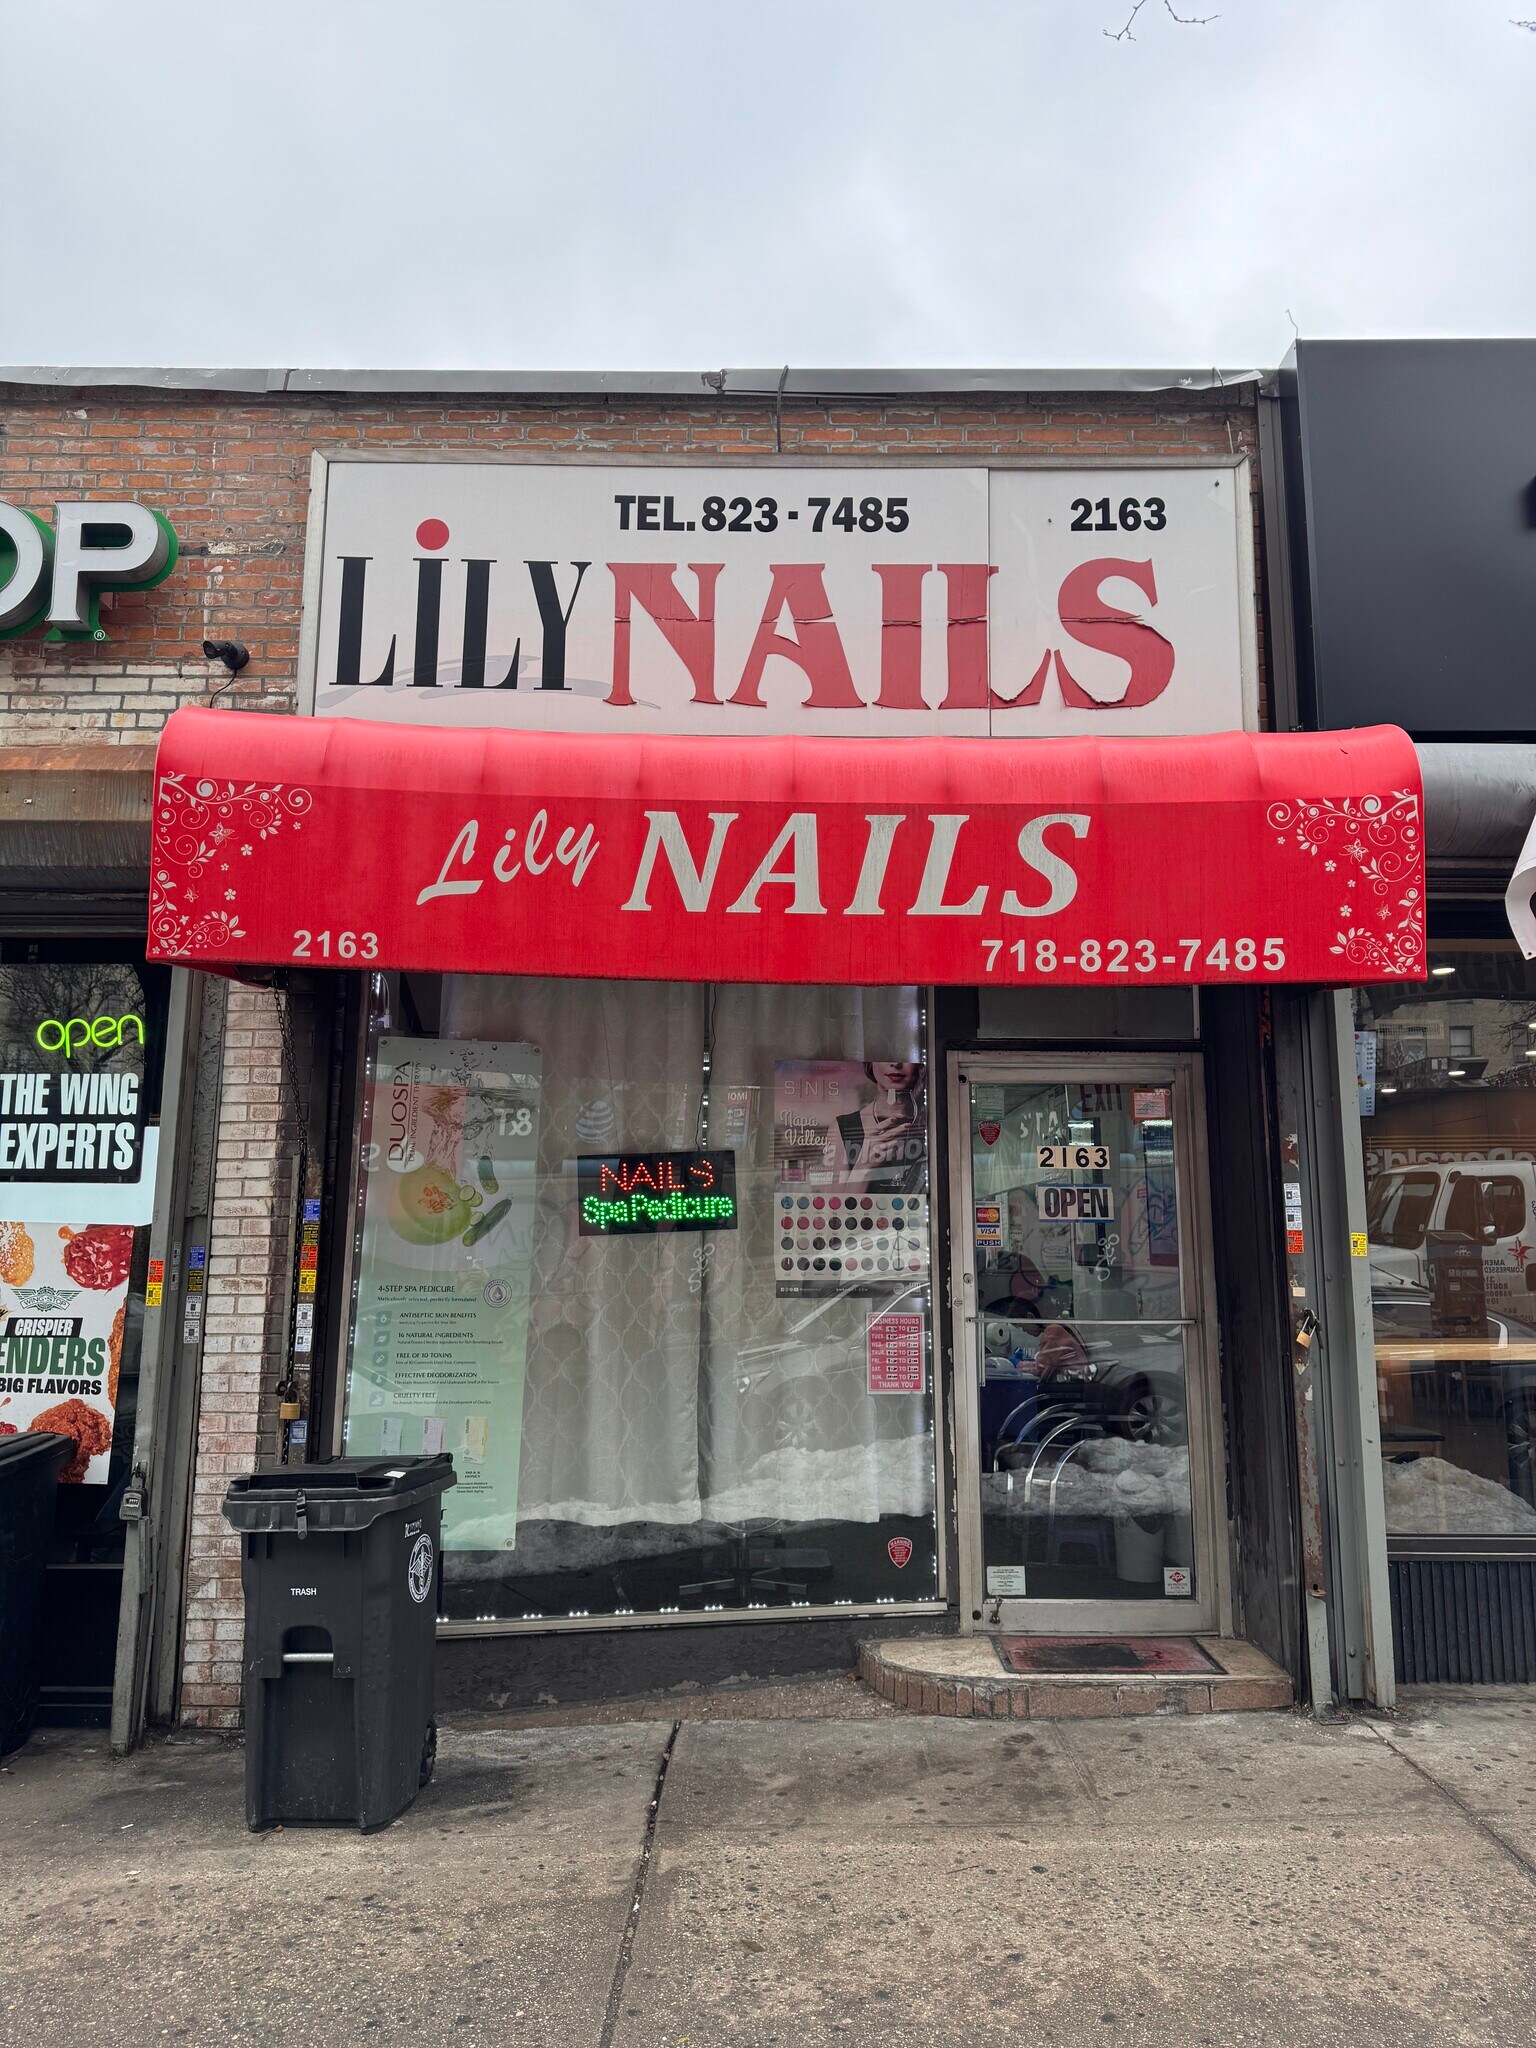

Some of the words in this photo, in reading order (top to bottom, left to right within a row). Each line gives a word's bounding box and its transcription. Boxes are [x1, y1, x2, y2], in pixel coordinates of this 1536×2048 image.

[1070, 497, 1167, 532] 2163
[602, 557, 1176, 710] NAILS
[416, 808, 600, 906] Lily
[620, 810, 1092, 918] NAILS
[292, 929, 380, 959] 2163
[981, 937, 1286, 973] 718-823-7485
[37, 1014, 144, 1059] open
[0, 1073, 51, 1115] THE
[60, 1072, 139, 1116] WING
[413, 1062, 422, 1097] THERAPY
[388, 1060, 411, 1162] DUOSPA
[410, 1099, 420, 1139] INGREDIENT
[780, 1109, 819, 1134] Napa
[0, 1121, 136, 1171] EXPERTS
[784, 1128, 831, 1155] Valley
[1040, 1147, 1108, 1168] 2163
[600, 1158, 715, 1193] NAILS
[1044, 1188, 1109, 1218] OPEN
[378, 1285, 403, 1293] 4-STEP
[404, 1285, 418, 1293] SPA
[419, 1285, 456, 1293] PEDICURE
[15, 1319, 74, 1336] CRISPIER
[27, 1379, 102, 1395] FLAVORS
[290, 1588, 317, 1596] TRASH
